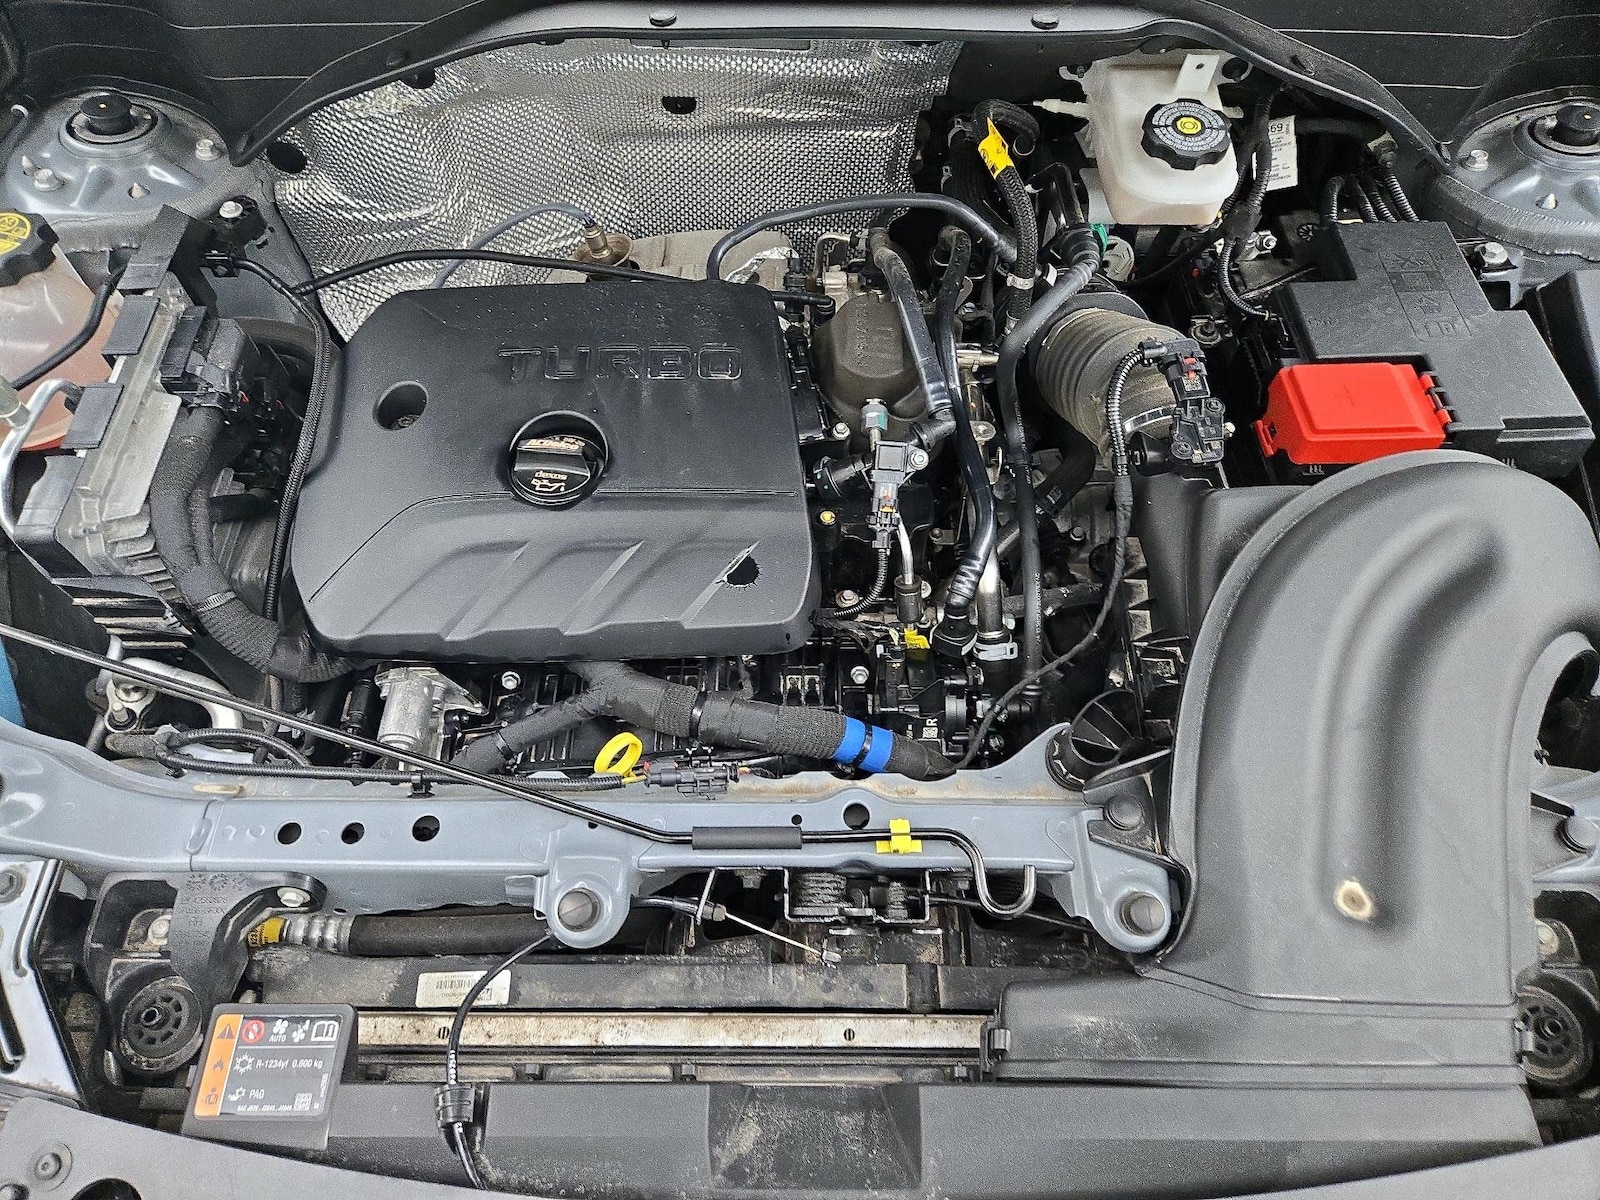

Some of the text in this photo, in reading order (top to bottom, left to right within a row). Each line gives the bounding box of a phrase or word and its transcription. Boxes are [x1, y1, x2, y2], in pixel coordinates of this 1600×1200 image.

[498, 344, 742, 380] TURBO
[534, 470, 568, 480] dexos
[268, 1034, 287, 1043] AUTO
[313, 1059, 324, 1070] kg
